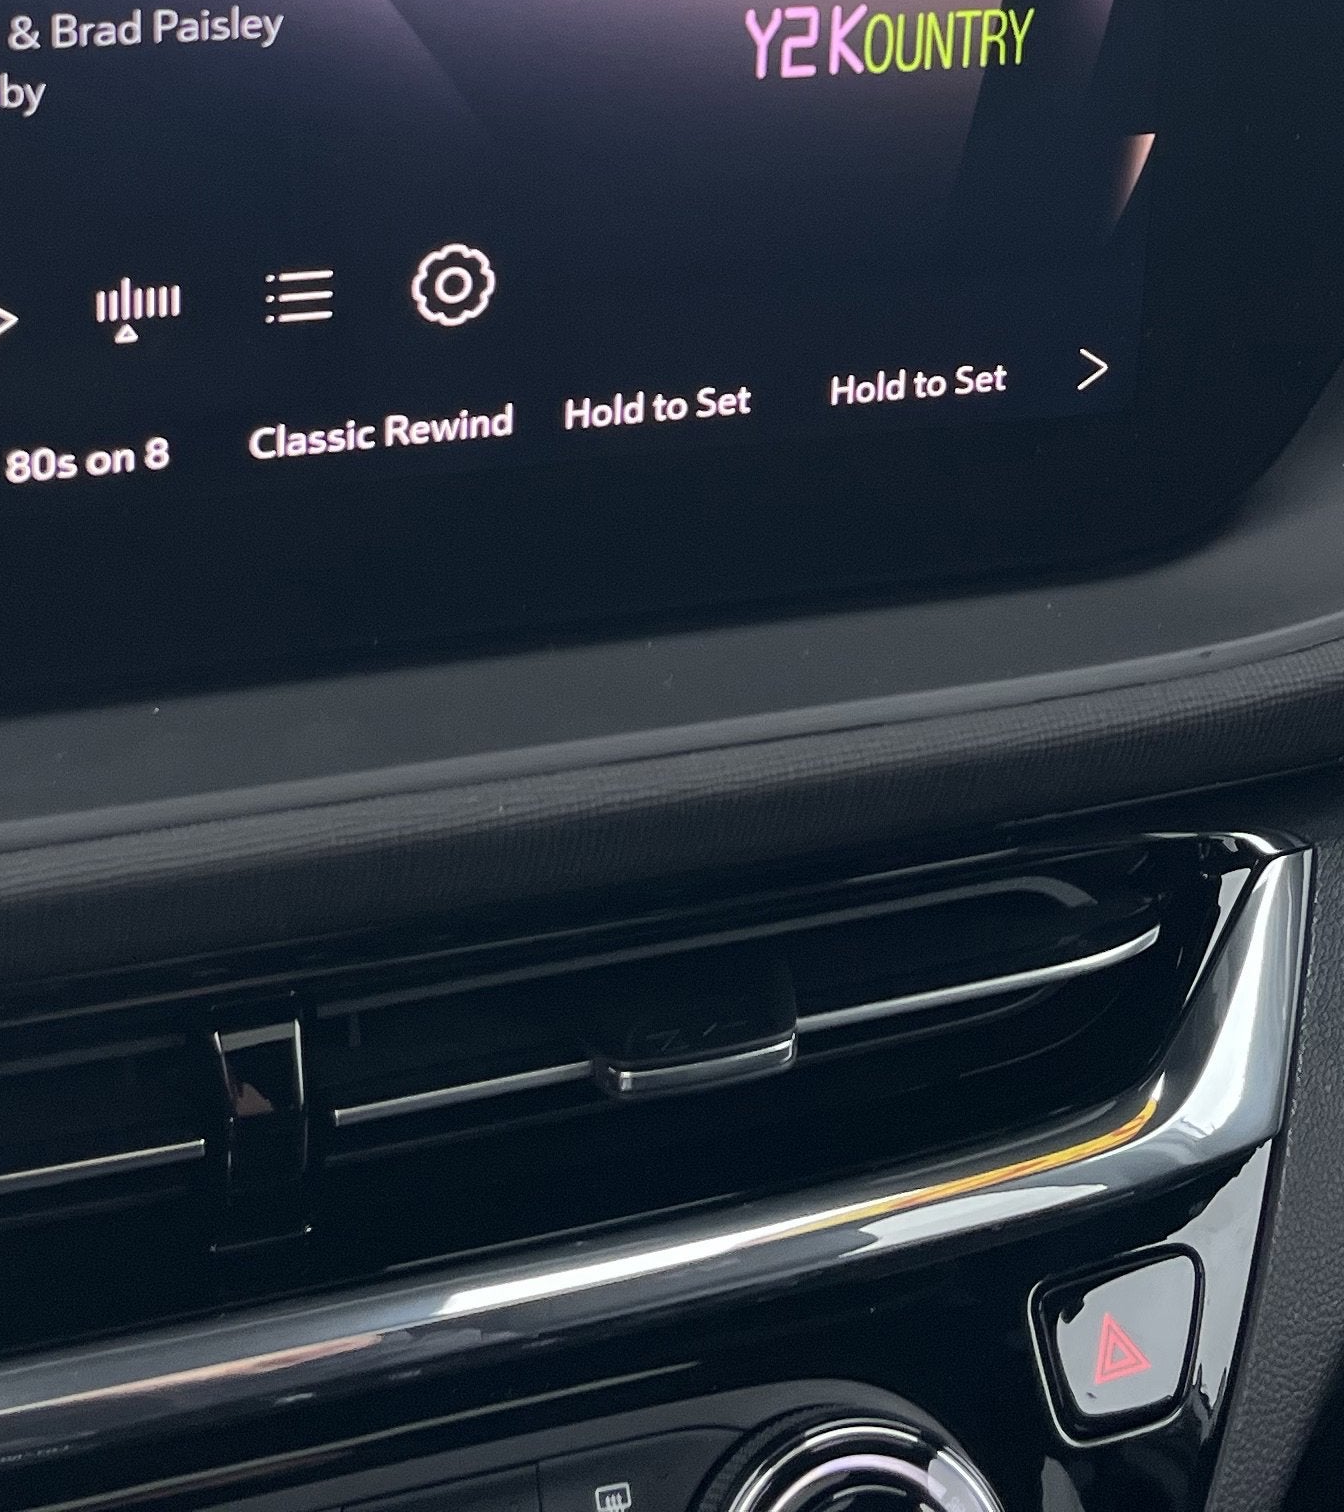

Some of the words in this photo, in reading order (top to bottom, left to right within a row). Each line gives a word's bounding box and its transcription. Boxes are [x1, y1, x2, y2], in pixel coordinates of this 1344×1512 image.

[8, 15, 41, 50] &
[51, 8, 142, 49] Brad
[153, 5, 285, 48] Paisley
[564, 390, 645, 430] Hold
[651, 393, 689, 422] to
[695, 386, 752, 418] Set
[830, 368, 906, 407] Hold
[913, 371, 947, 399] to
[954, 364, 1008, 395] Set
[248, 419, 376, 461] Classic
[384, 402, 514, 448] Rewind
[5, 447, 78, 484] 80s
[85, 448, 136, 476] on
[144, 436, 170, 470] 8
